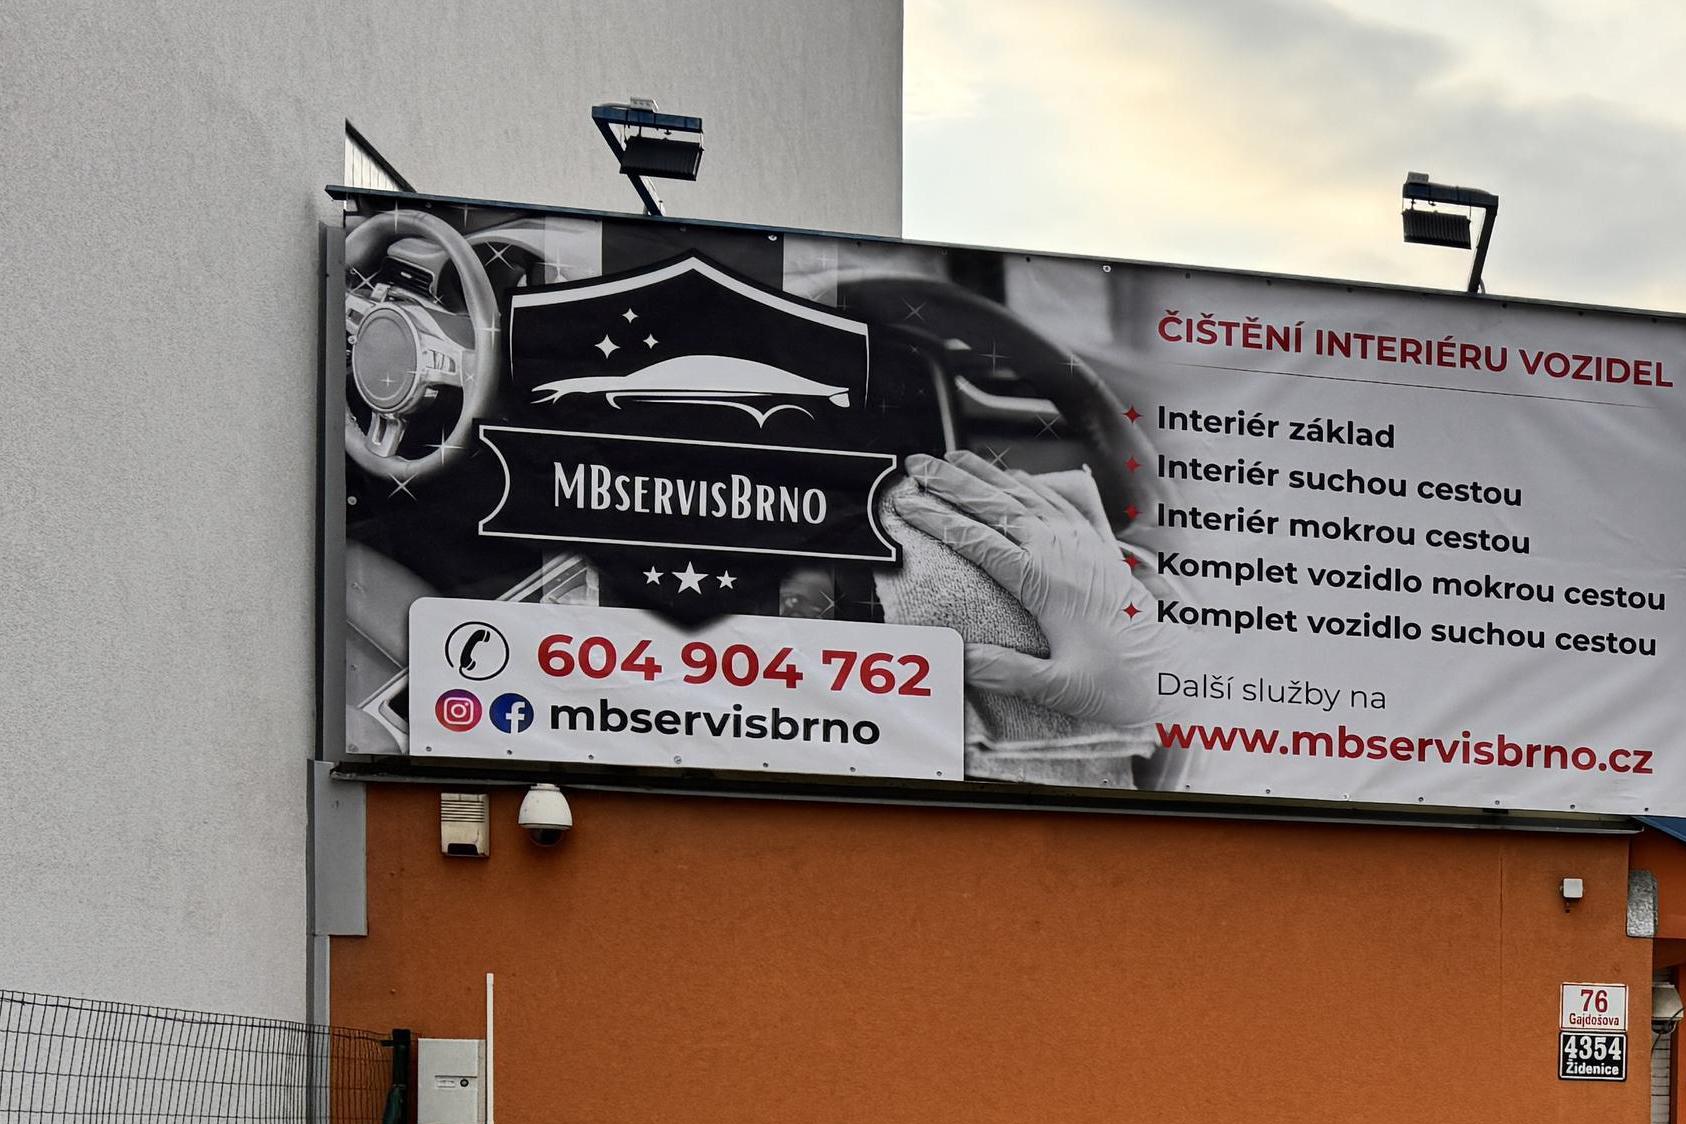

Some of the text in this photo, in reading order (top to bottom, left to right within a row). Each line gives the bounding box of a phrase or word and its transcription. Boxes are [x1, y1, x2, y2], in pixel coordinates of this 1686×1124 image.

[1158, 308, 1674, 388] ČIŠTĚNÍ INTERIÉRU VOZIDEL
[1157, 404, 1396, 450] Interiér základ
[1157, 453, 1522, 507] Interiér suchou cestou
[1157, 502, 1531, 556] Interiér mokrou cestou
[1156, 550, 1666, 611] Komplet vozidlo mokrou cestou
[1156, 598, 1657, 656] Komplet vozidlo suchou cestou
[537, 634, 932, 698] 604 904 762
[1157, 671, 1387, 712] Další služby na
[549, 698, 881, 746] mbservisbrno
[1155, 722, 1654, 776] www.mbservisbrno.cz
[1569, 1013, 1620, 1027] Gajdošova
[1580, 989, 1609, 1013] 76
[1564, 1035, 1622, 1061] 4354
[1565, 1059, 1619, 1075] Židenice
